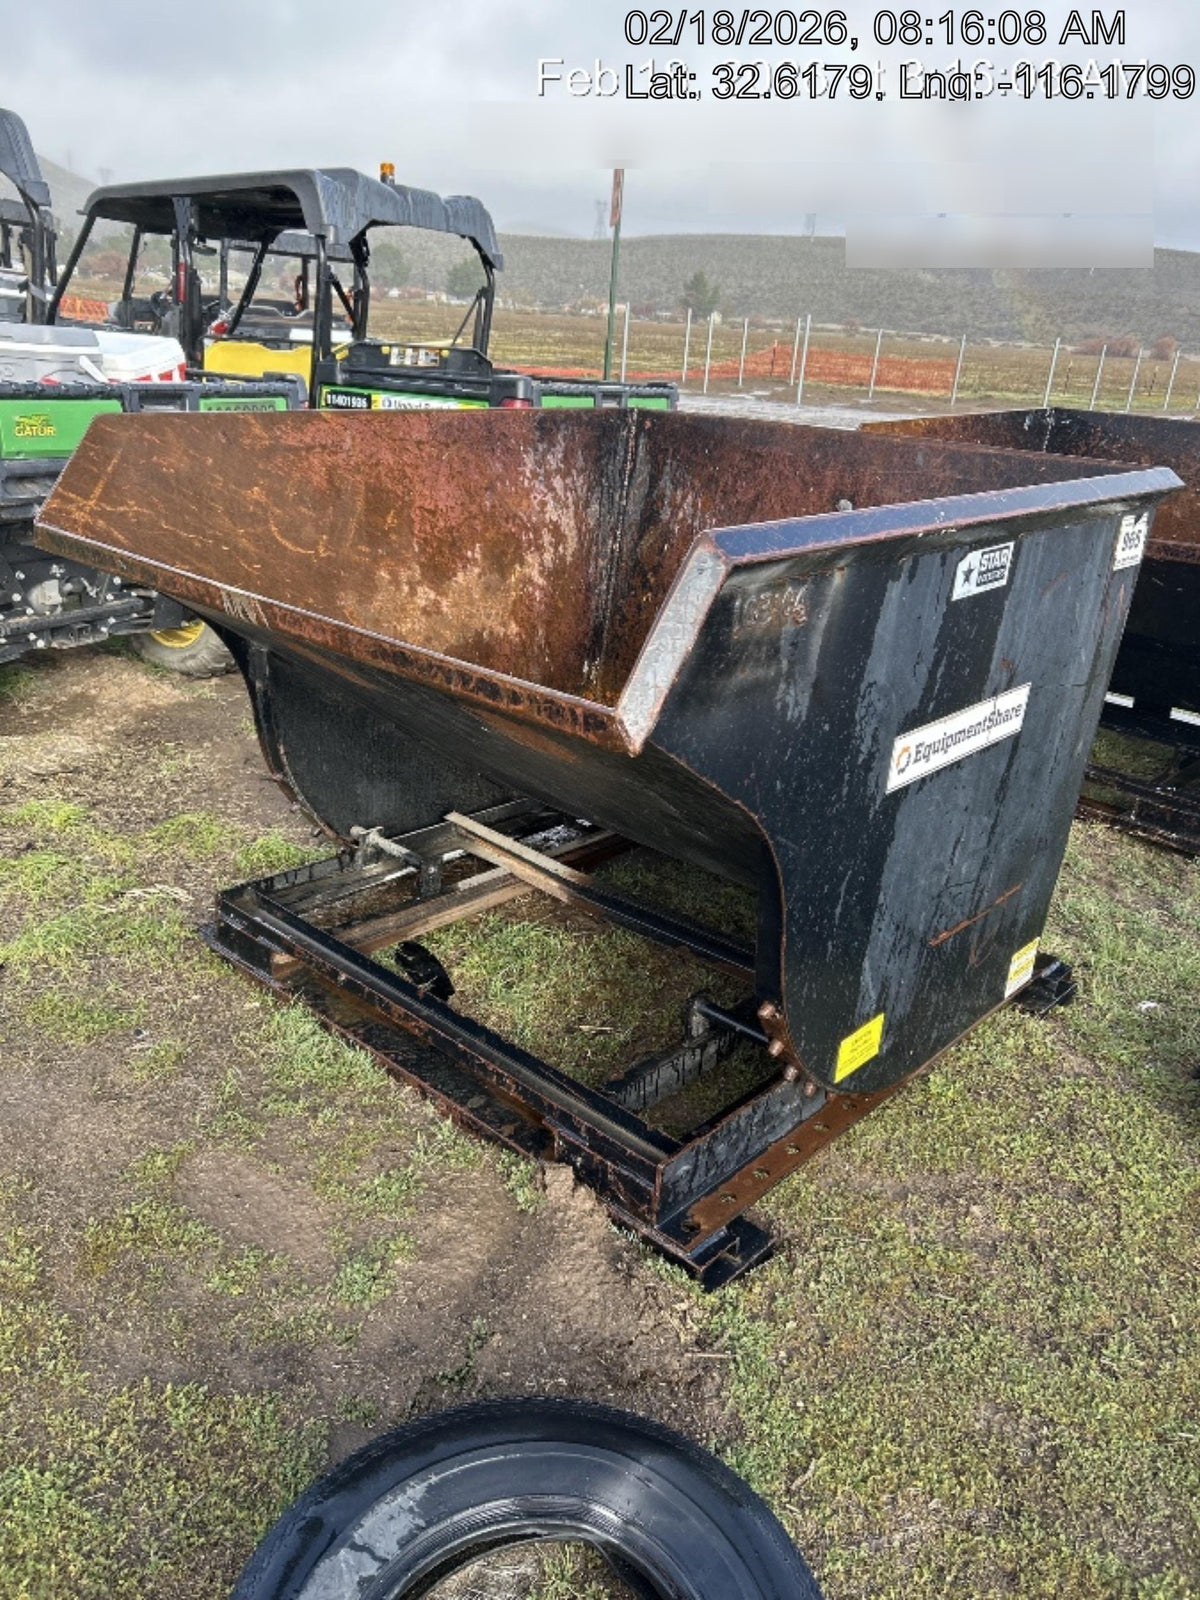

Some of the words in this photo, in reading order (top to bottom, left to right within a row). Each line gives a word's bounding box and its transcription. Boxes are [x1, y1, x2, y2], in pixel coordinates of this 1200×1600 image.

[15, 426, 54, 437] GATOR
[980, 548, 1010, 571] STAR
[912, 702, 1023, 765] EquipmentShare
